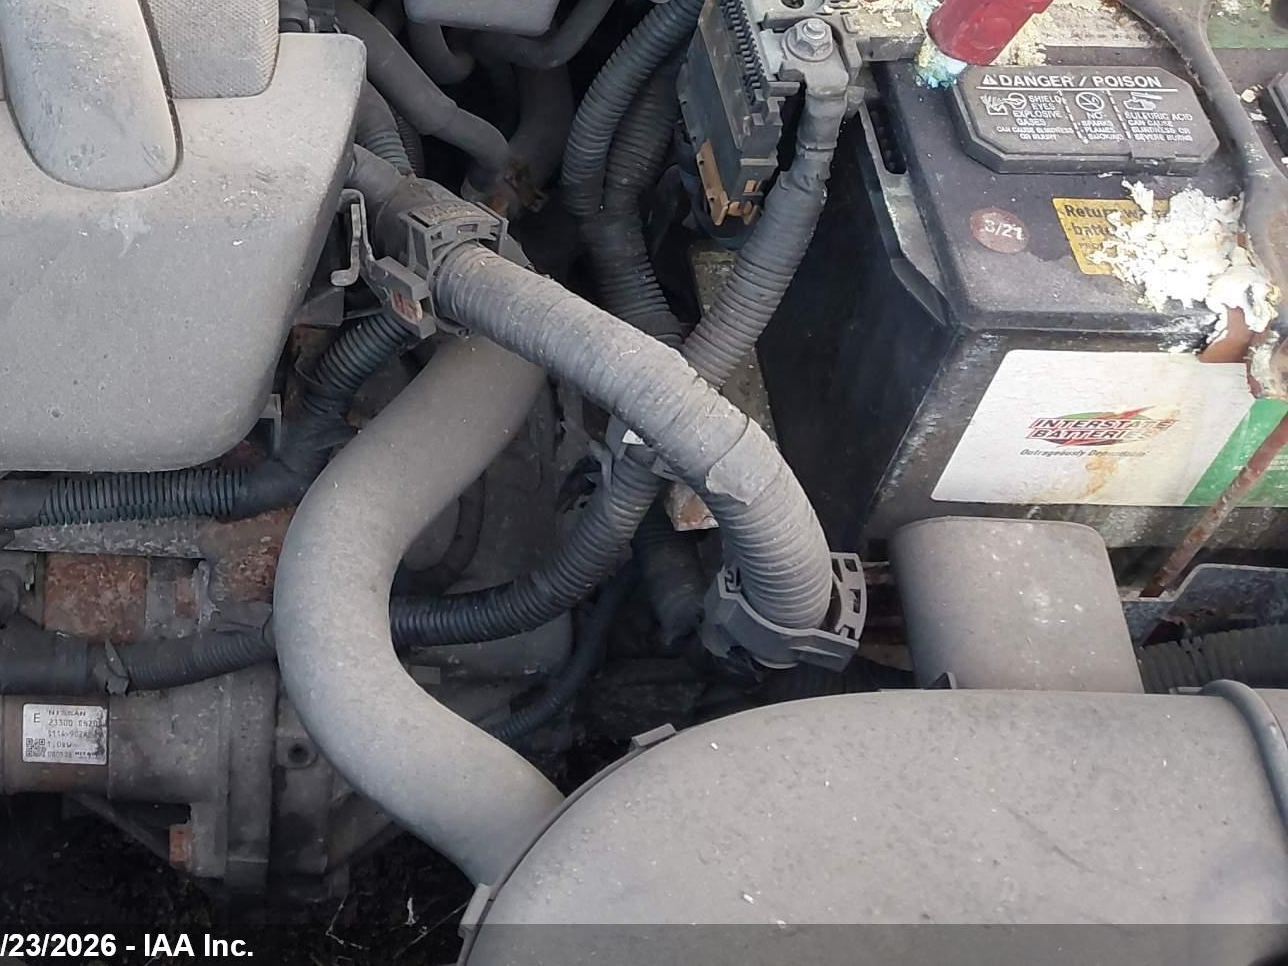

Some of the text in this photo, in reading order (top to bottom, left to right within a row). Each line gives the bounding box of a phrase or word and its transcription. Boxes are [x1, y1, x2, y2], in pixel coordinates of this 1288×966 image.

[999, 74, 1073, 87] DANGER
[1093, 76, 1163, 88] POISON
[1028, 94, 1061, 104] SHIELD
[1031, 103, 1056, 111] EYES
[1012, 110, 1063, 118] EXPLOSIVE
[1086, 112, 1103, 120] NO
[1125, 111, 1193, 121] SULFURIC ACID
[1016, 118, 1047, 126] GASES
[1035, 418, 1173, 430] INTERSTATE
[33, 712, 41, 723] E
